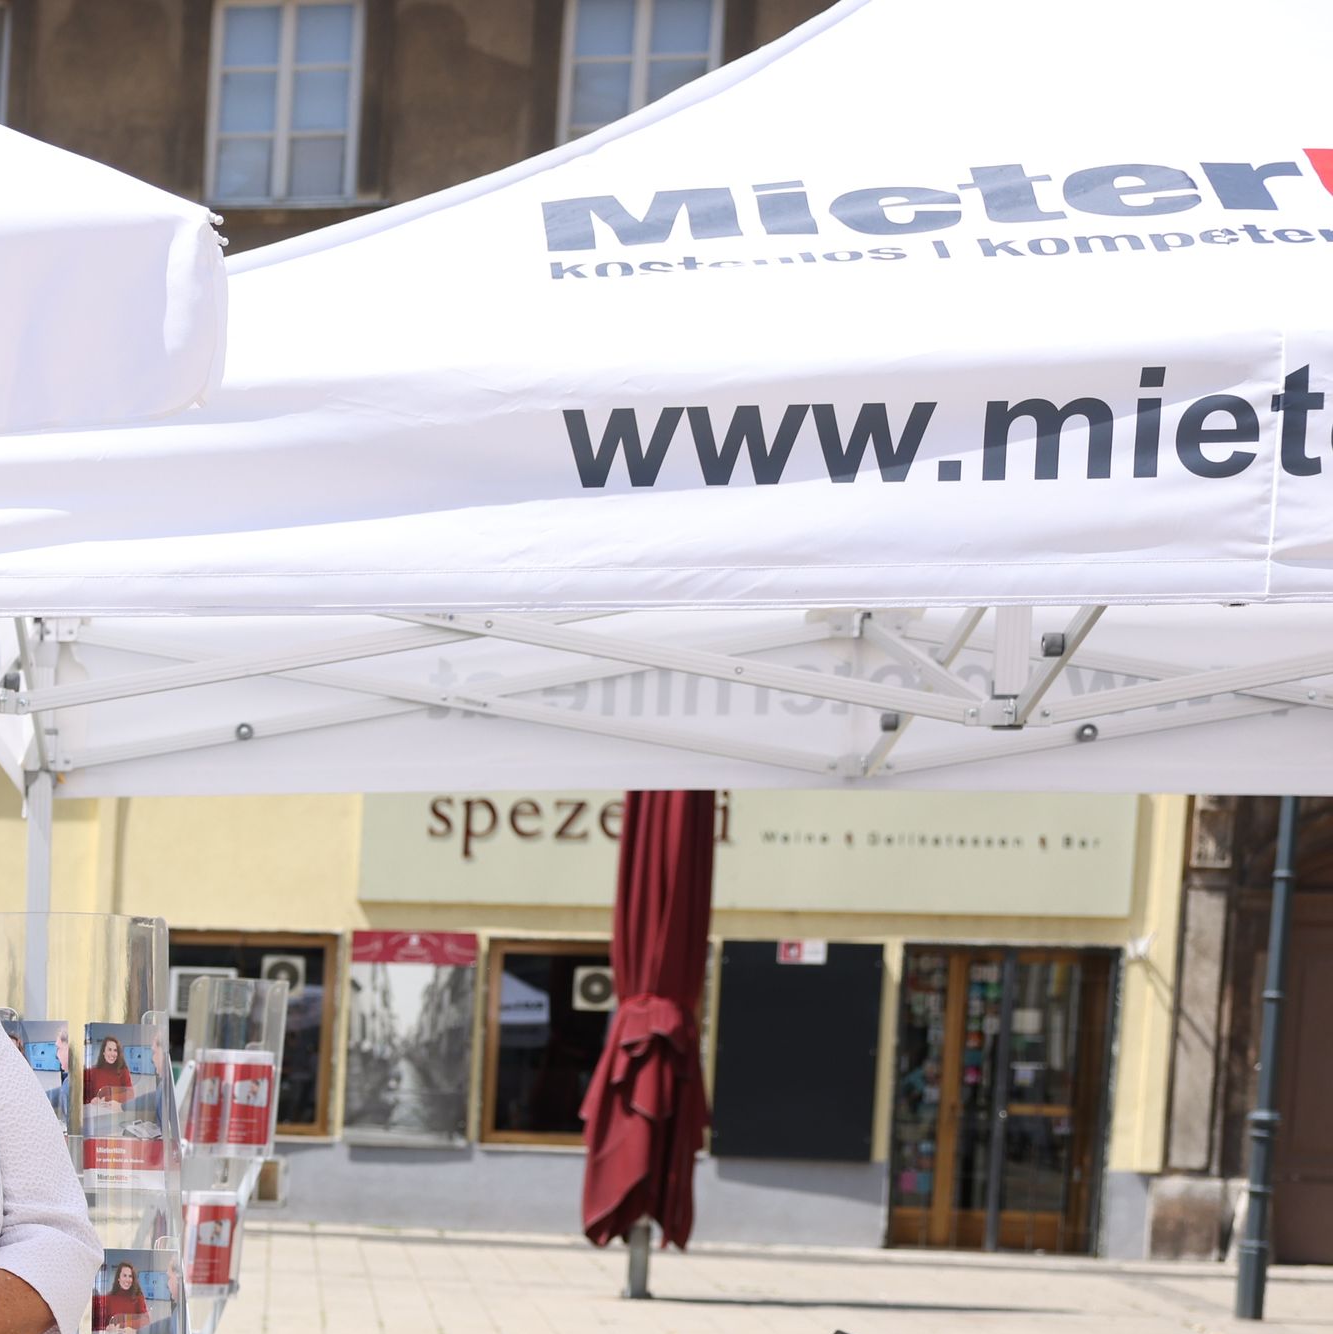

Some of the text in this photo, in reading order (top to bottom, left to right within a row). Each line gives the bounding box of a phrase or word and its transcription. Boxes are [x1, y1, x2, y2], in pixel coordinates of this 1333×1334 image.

[541, 147, 1333, 252] Mieter
[562, 363, 1333, 488] www.miet
[427, 789, 734, 861] spezei
